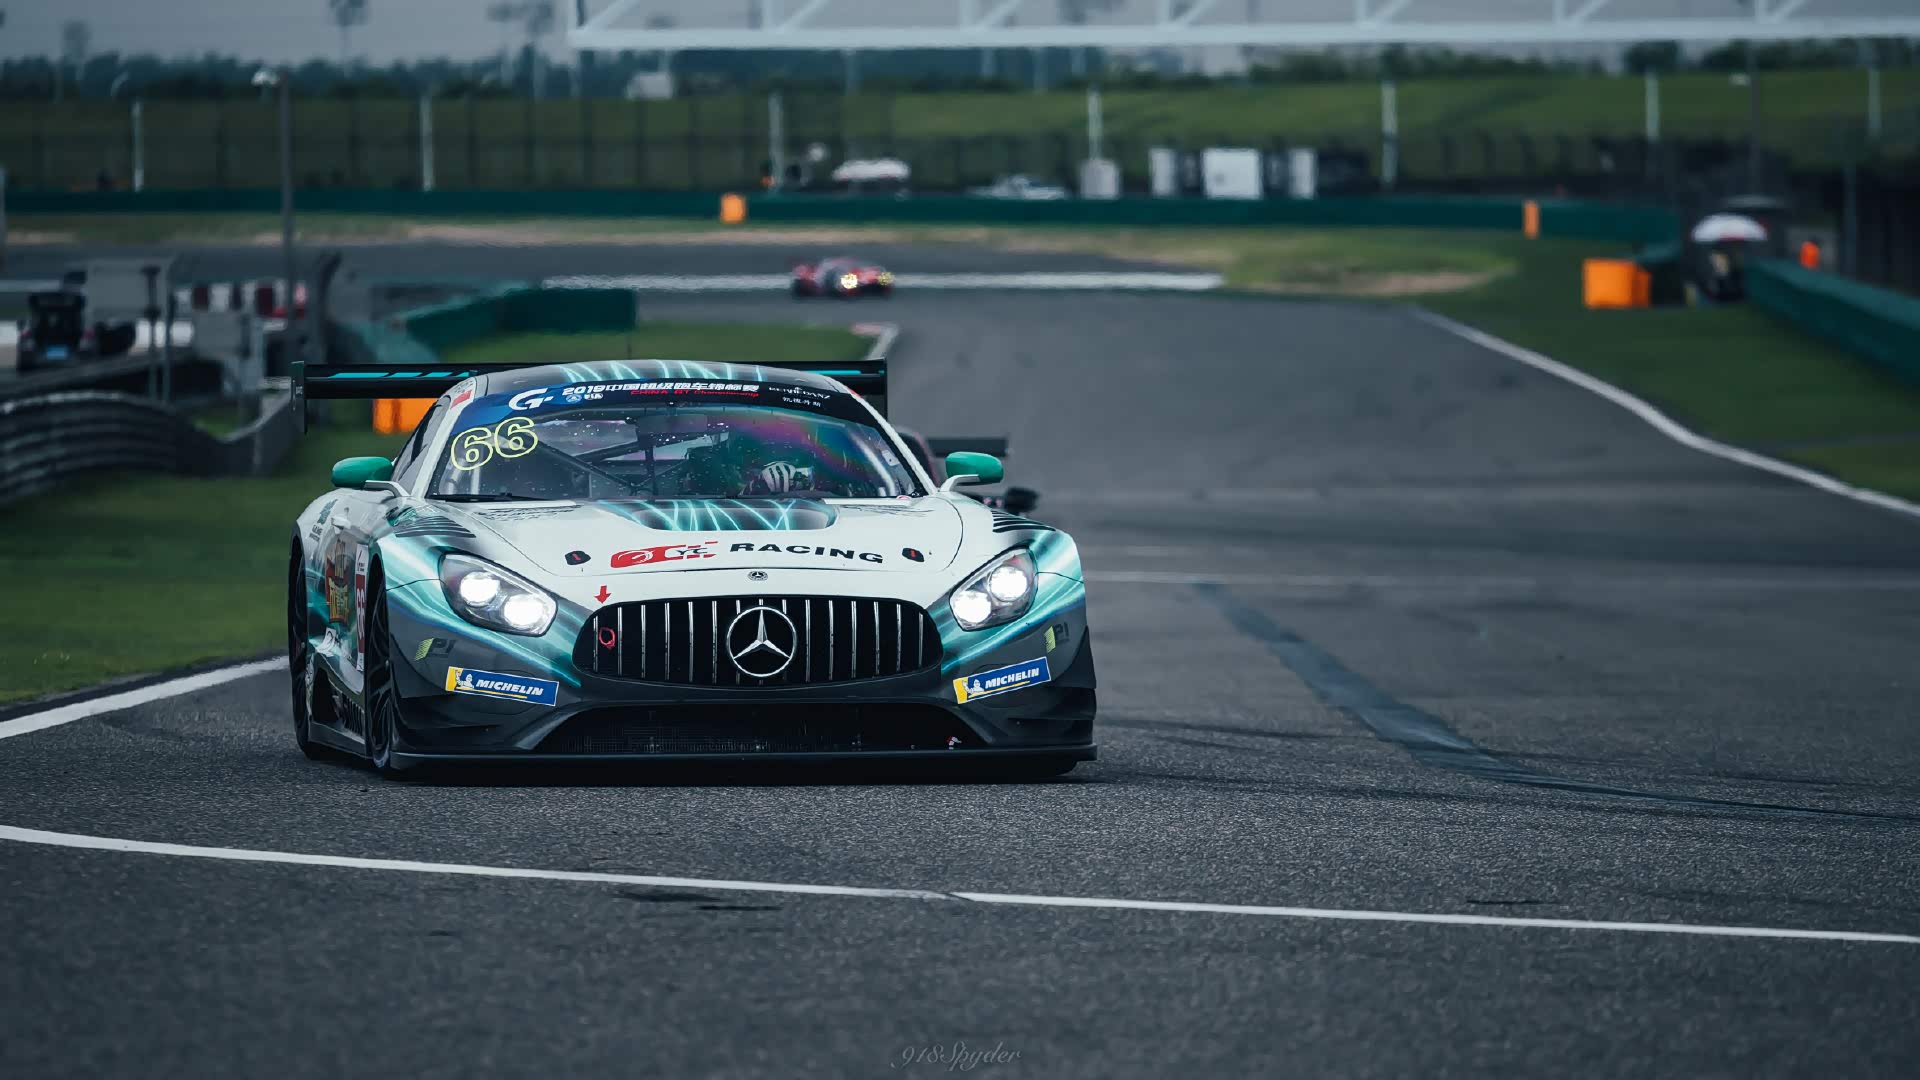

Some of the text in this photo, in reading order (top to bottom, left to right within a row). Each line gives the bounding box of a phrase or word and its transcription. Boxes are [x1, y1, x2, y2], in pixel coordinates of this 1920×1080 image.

[451, 416, 538, 471] 66
[729, 543, 884, 564] RACING
[475, 679, 545, 697] MICHELIN
[984, 667, 1040, 690] MICHELIN
